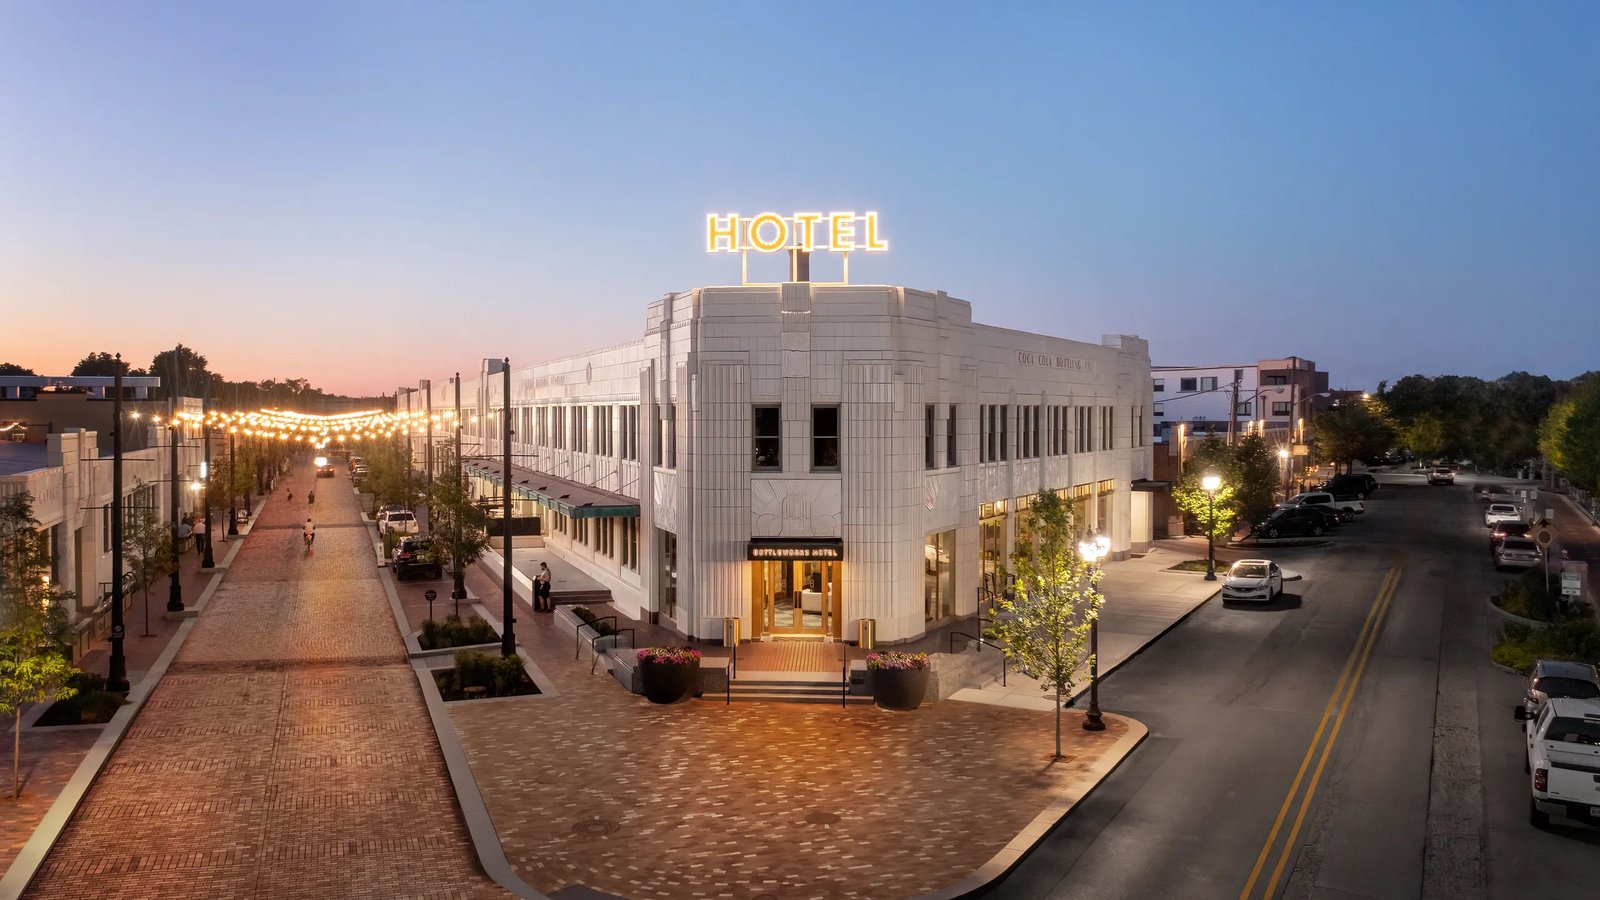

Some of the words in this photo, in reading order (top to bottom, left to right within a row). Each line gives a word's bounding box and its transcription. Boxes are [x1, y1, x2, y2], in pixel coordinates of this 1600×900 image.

[706, 211, 889, 252] HOTEL
[1017, 351, 1034, 365] COCA
[1038, 354, 1052, 367] COLA
[1056, 356, 1082, 370] BOTTLING
[752, 548, 810, 557] BOTTLEWORKS
[812, 548, 838, 557] HOTEL
